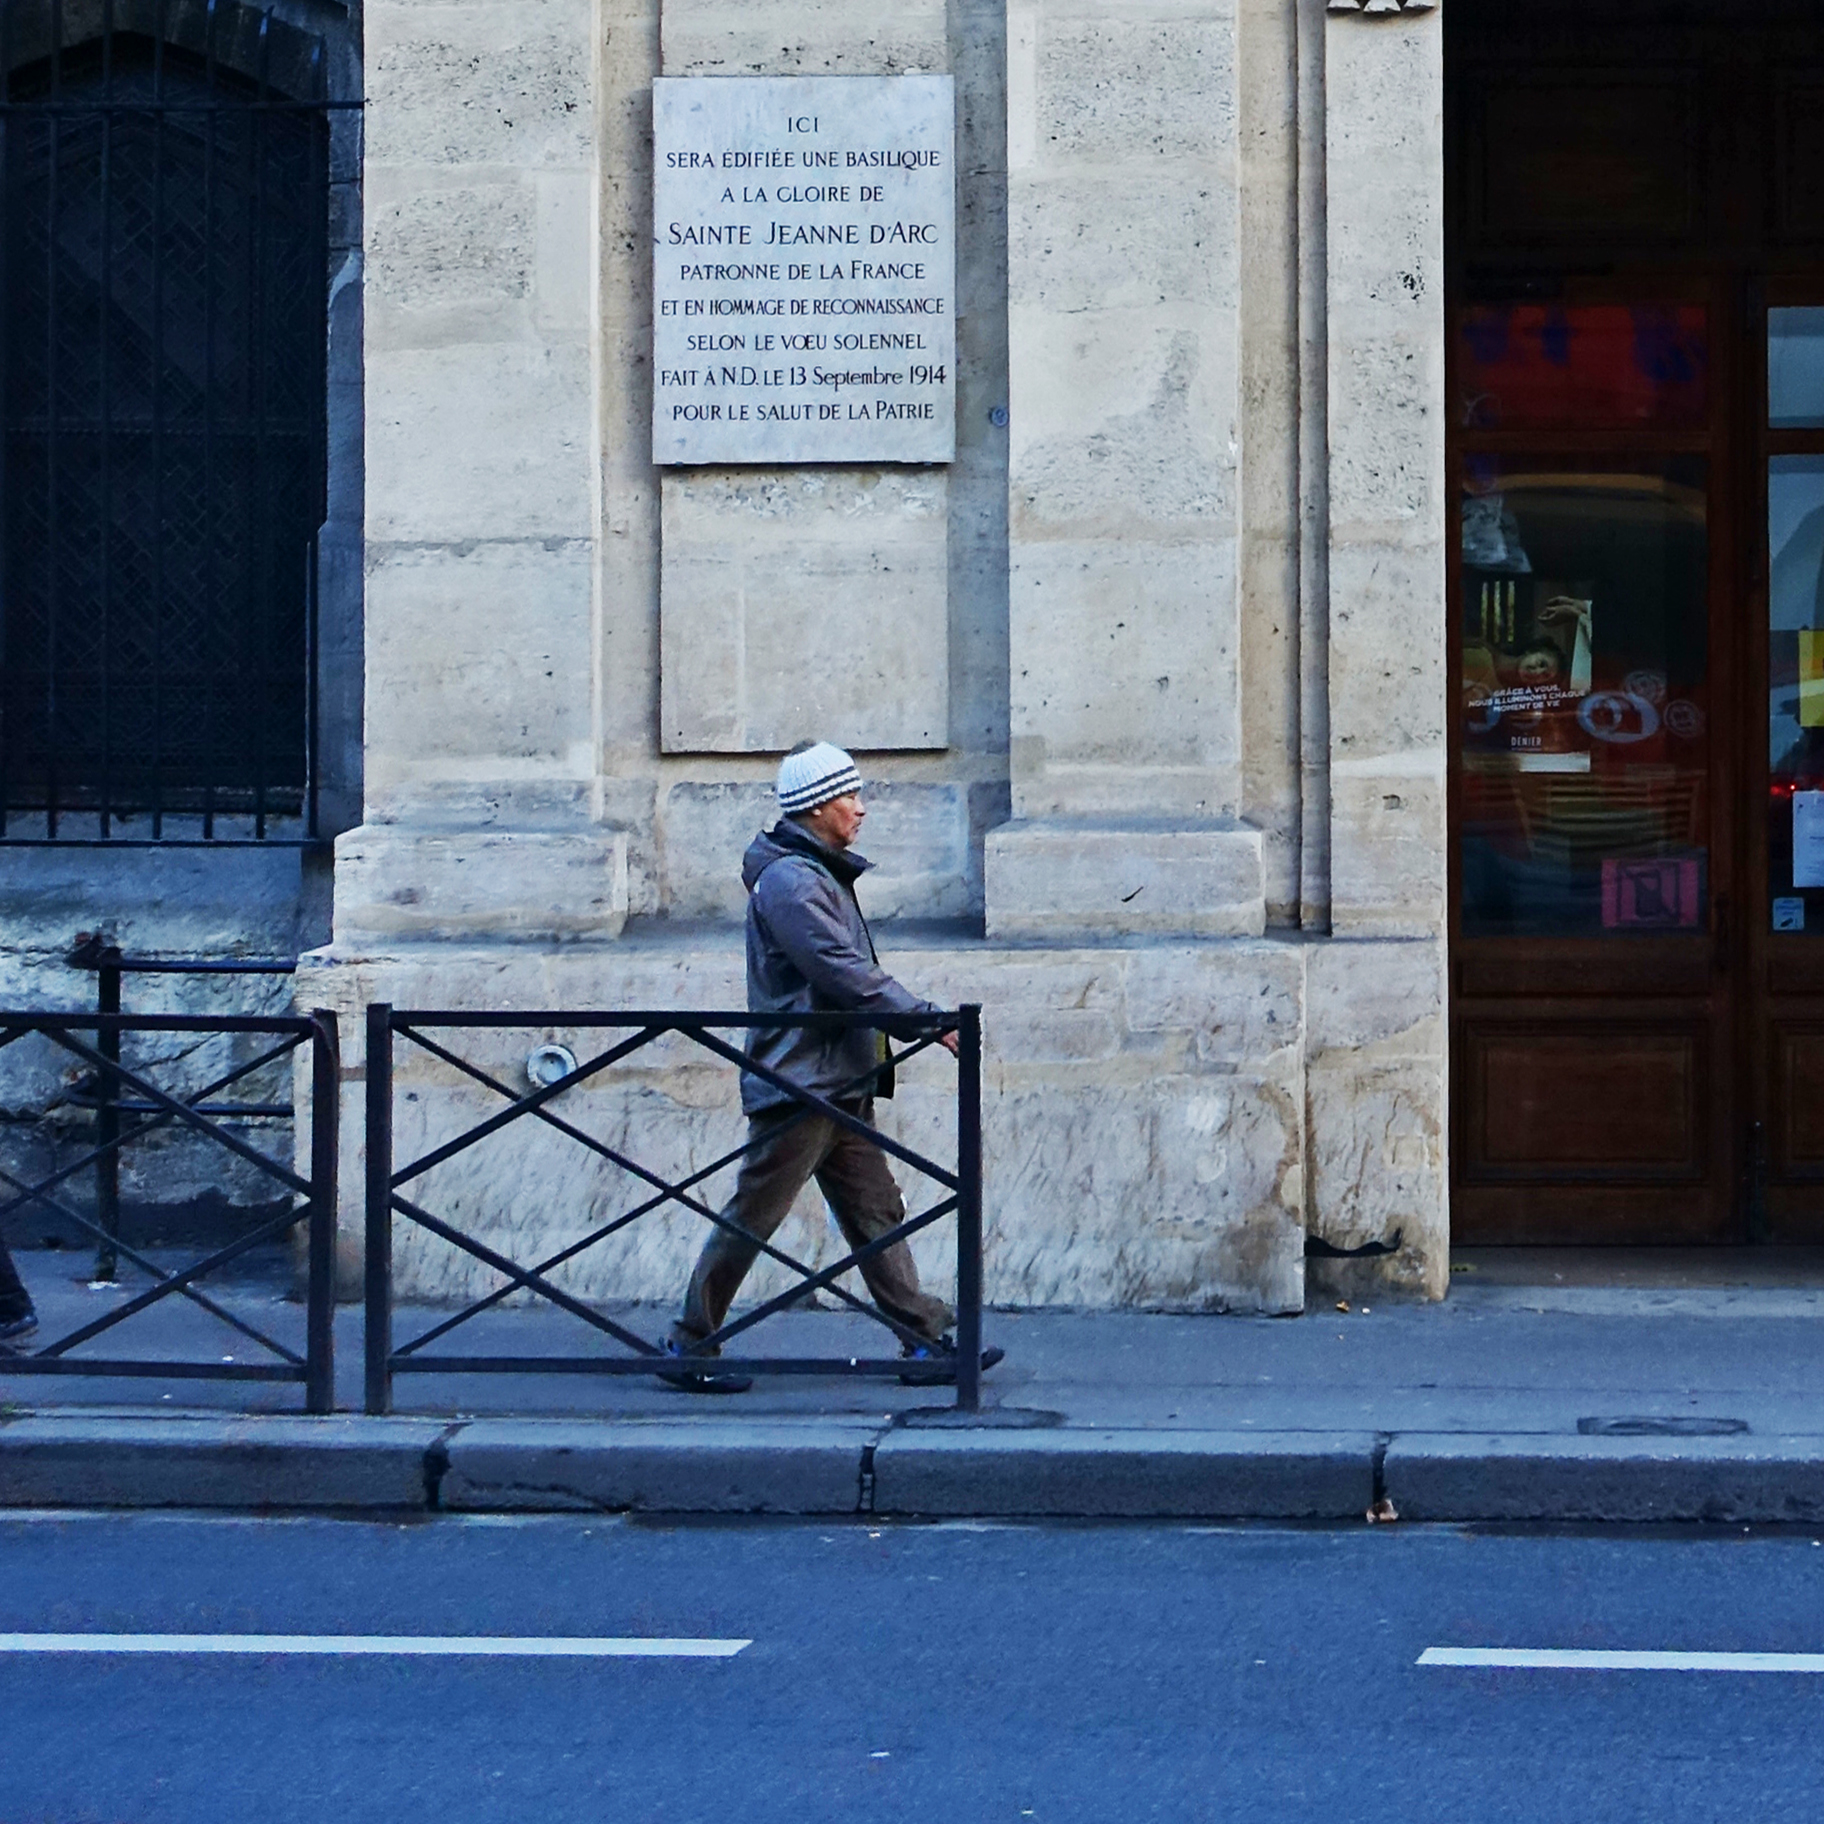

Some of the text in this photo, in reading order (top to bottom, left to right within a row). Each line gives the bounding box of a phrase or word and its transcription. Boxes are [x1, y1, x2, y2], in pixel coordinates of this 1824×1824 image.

[789, 117, 817, 132] ICI
[667, 149, 939, 170] SERA ÉDIFIÉE UNE BASILIQUE
[744, 187, 767, 202] LA
[777, 187, 849, 202] GLOIRE
[861, 186, 883, 201] DE
[681, 260, 925, 280] PATRONNE DE LA FRANCE
[662, 299, 943, 315] ET EN HOMMAGE DE RECONNAISSANCE
[688, 335, 745, 350] SELON
[755, 335, 774, 350] LE
[834, 334, 926, 350] SOLENNEL
[662, 371, 698, 385] FAIT
[764, 370, 783, 385] LE
[791, 367, 806, 385] 13
[813, 366, 903, 392] Septembre
[911, 365, 946, 384] 1914
[674, 401, 933, 420] POUR LE SALUT DE LA PATRIE
